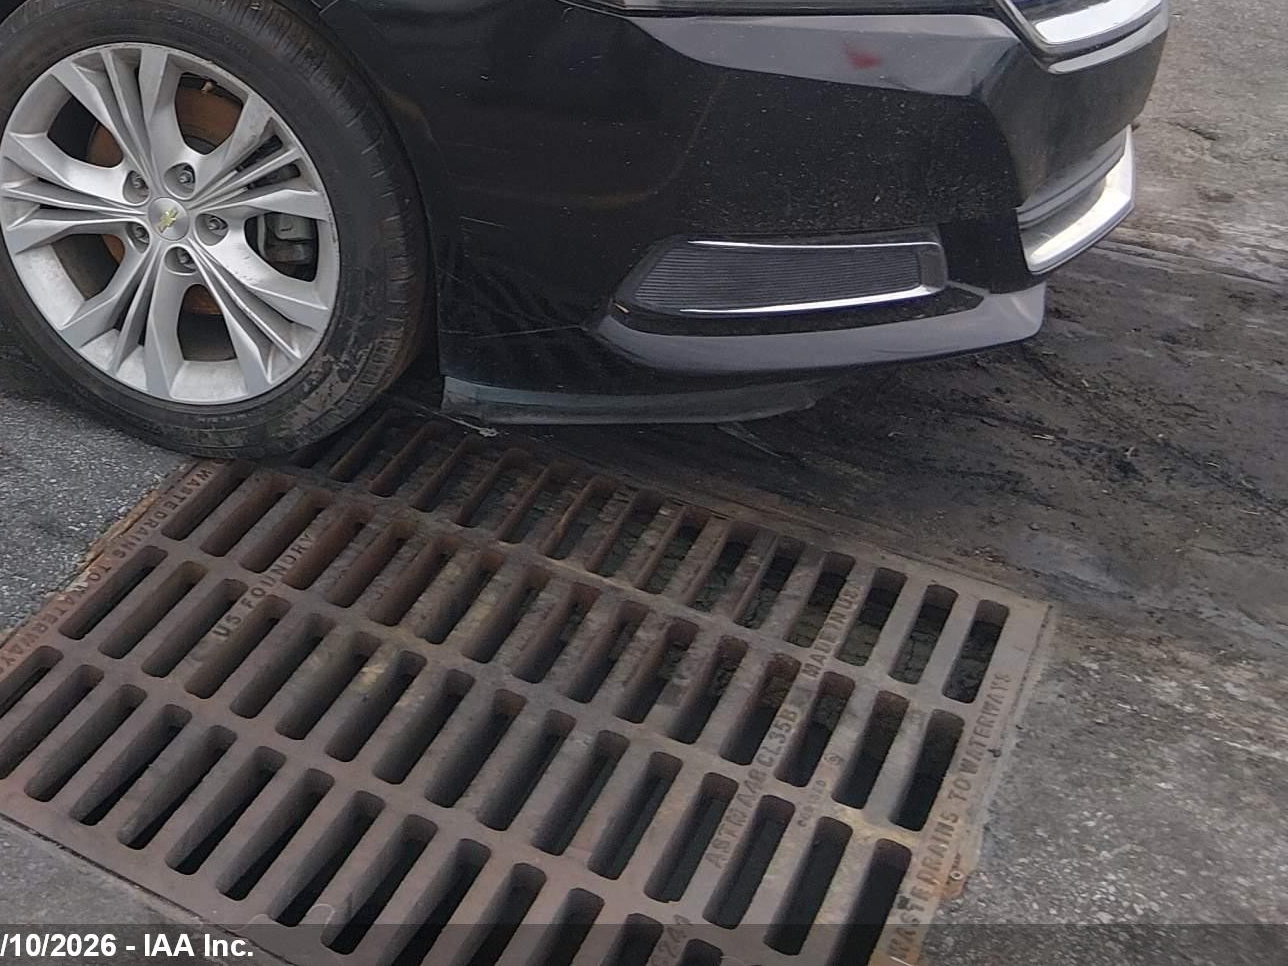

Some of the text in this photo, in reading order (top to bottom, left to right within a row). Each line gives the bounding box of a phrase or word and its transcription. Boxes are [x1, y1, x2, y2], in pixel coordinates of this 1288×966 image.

[86, 564, 112, 583] TO
[212, 532, 314, 638] US FOUNDRY
[959, 673, 1011, 775] WATERWAYS
[948, 777, 972, 802] TO
